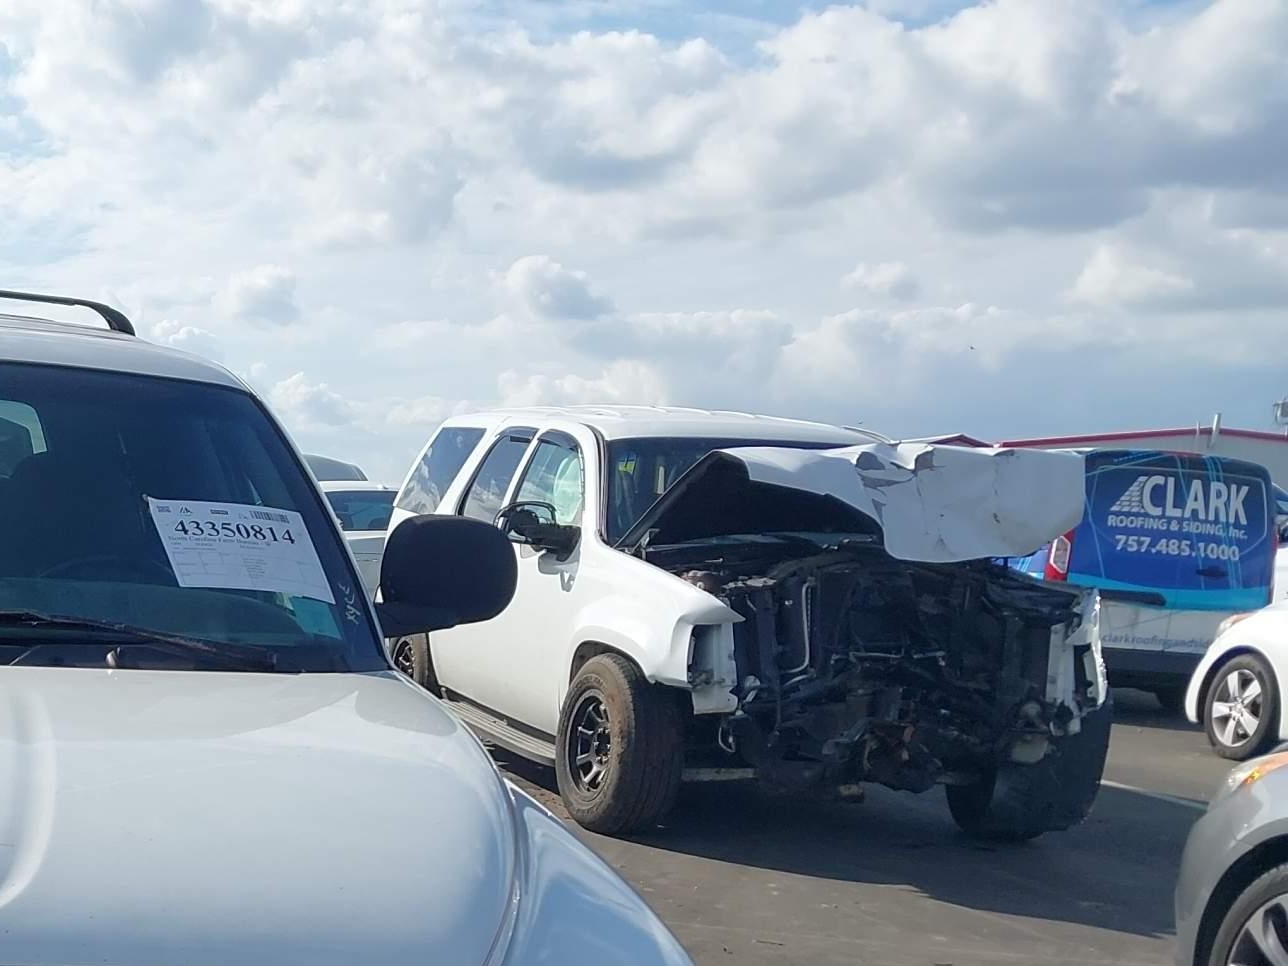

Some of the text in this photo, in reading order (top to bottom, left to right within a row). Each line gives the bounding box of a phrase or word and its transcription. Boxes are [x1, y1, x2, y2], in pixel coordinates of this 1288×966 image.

[1142, 475, 1250, 526] CLARK
[174, 519, 296, 545] 43350814
[1107, 514, 1168, 531] ROOFING
[1170, 519, 1180, 531] &
[1228, 525, 1248, 539] Inc.
[1115, 535, 1240, 561] 757.485.1000
